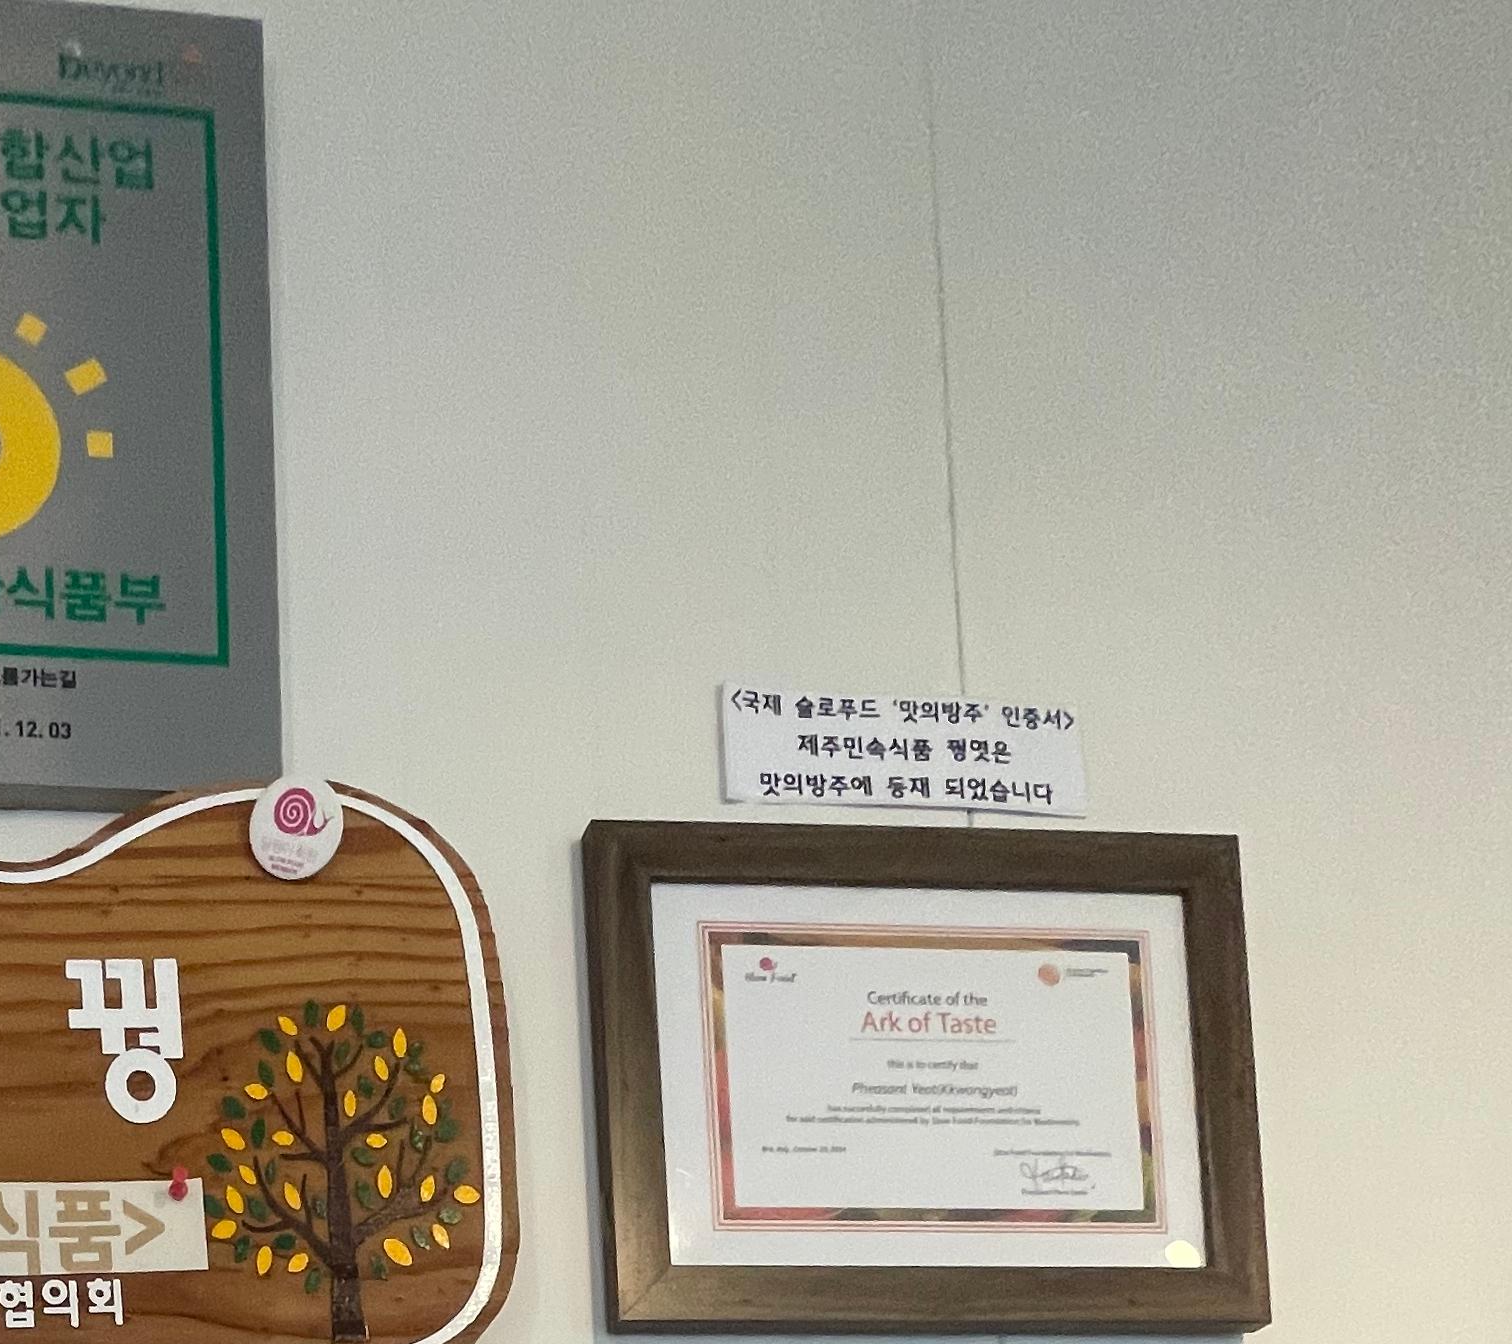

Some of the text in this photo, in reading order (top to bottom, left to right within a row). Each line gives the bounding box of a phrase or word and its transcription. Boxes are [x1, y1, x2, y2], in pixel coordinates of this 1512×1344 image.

[795, 696, 880, 719] 슬로푸드
[49, 721, 72, 740] 03
[797, 733, 1012, 764] 제주민속식품 꿩엿은
[759, 772, 1053, 805] 맛의방주에 등재 되었습니다
[867, 990, 988, 1007] Certificate of the
[861, 1011, 997, 1035] Ark of Taste
[66, 957, 183, 1124] 꿩
